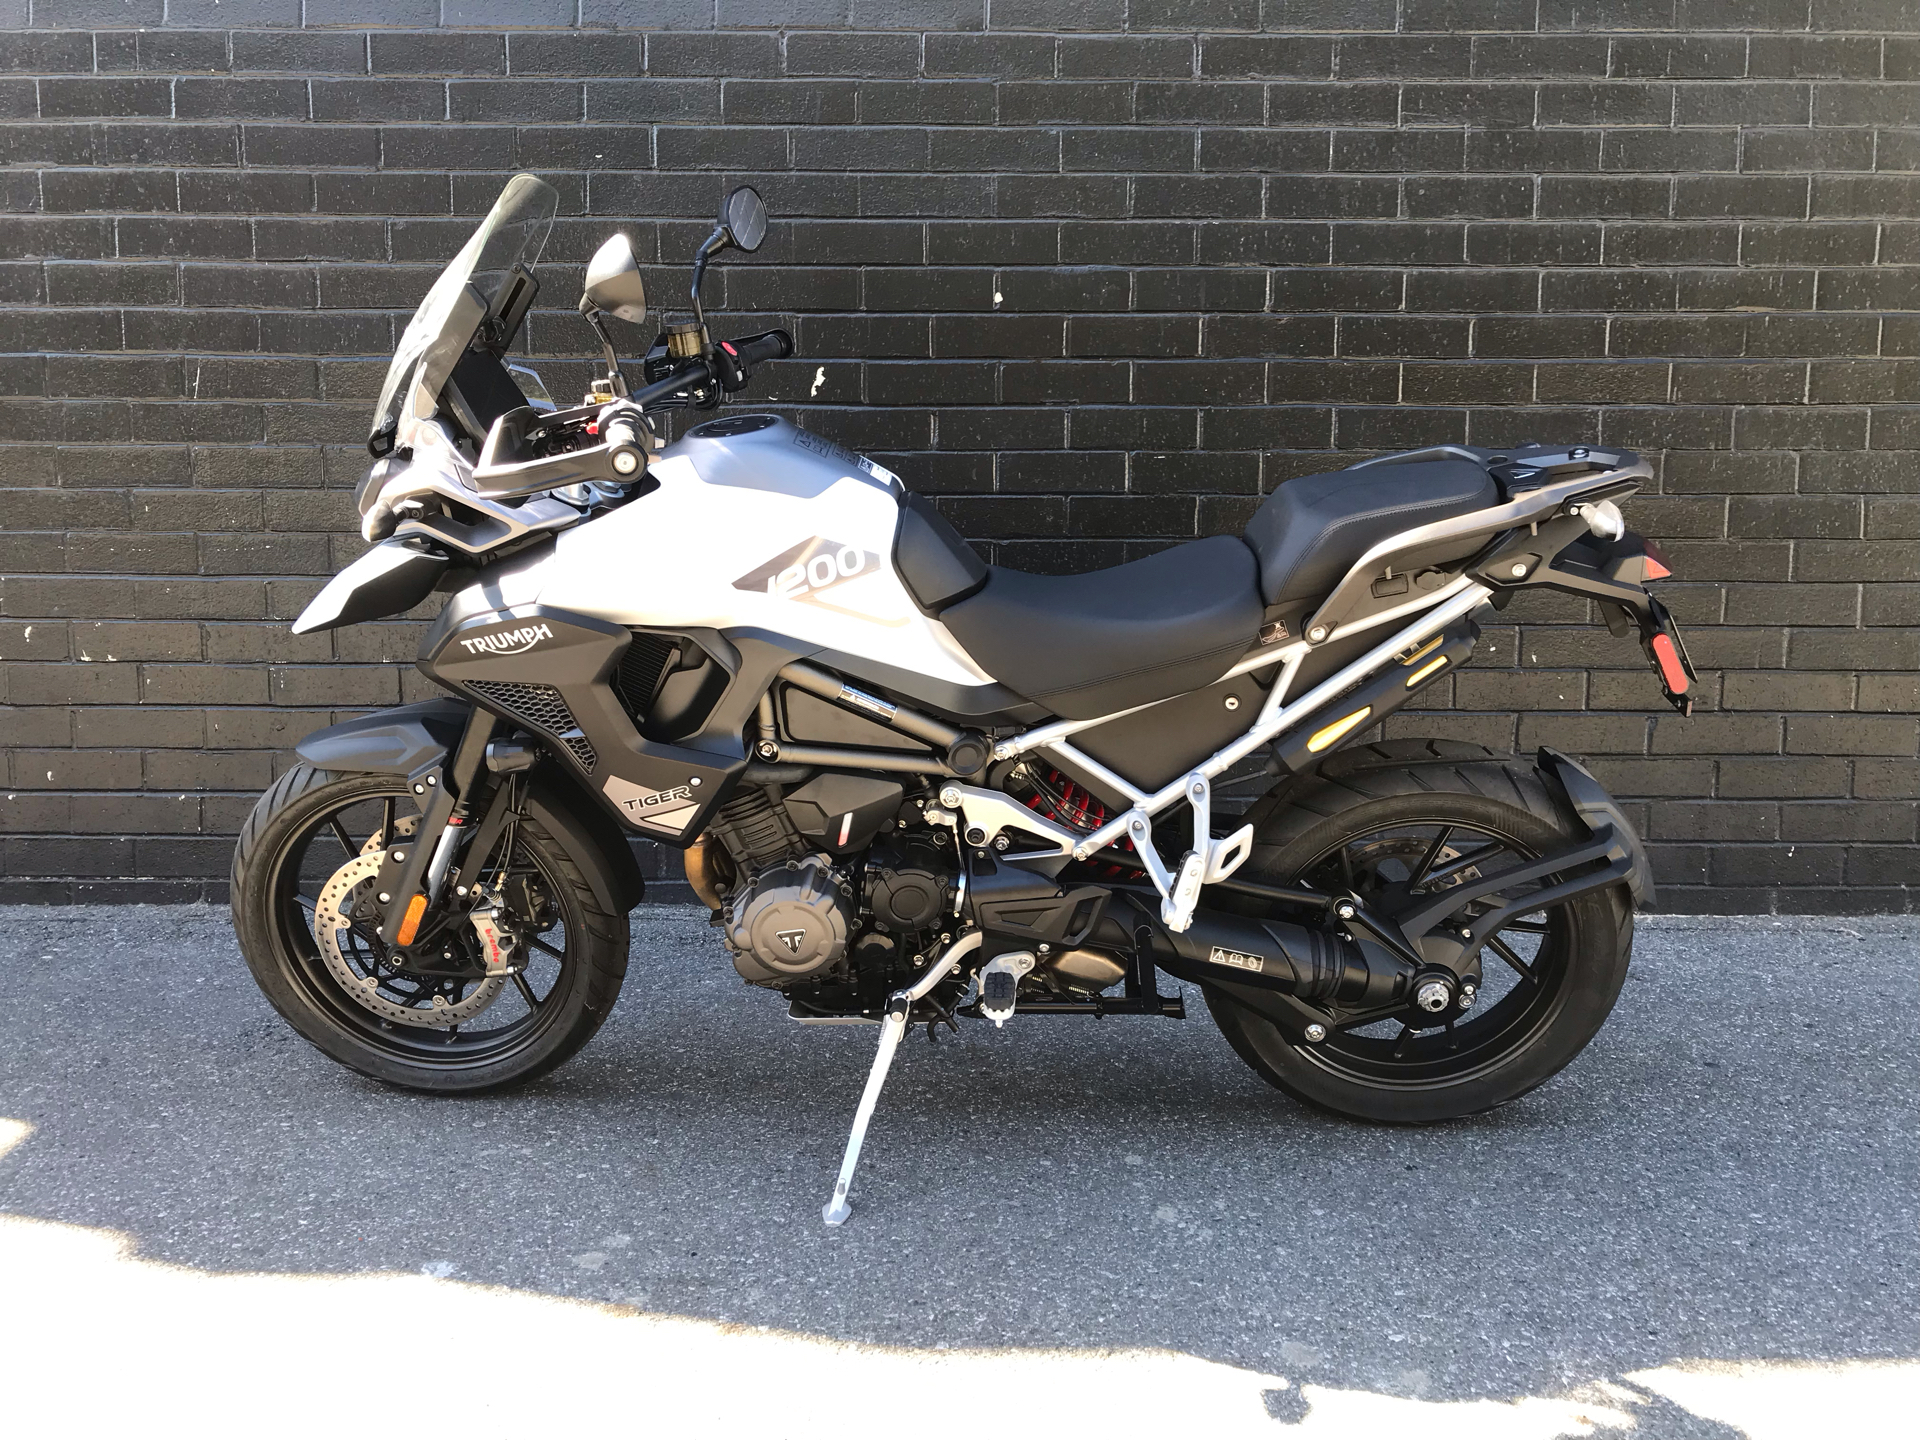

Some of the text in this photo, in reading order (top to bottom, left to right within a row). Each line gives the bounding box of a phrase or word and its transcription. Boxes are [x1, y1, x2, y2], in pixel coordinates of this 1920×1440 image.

[767, 544, 866, 600] 1200
[460, 623, 554, 655] TRIUMPH
[622, 785, 692, 811] TIGER
[485, 927, 500, 963] brembo
